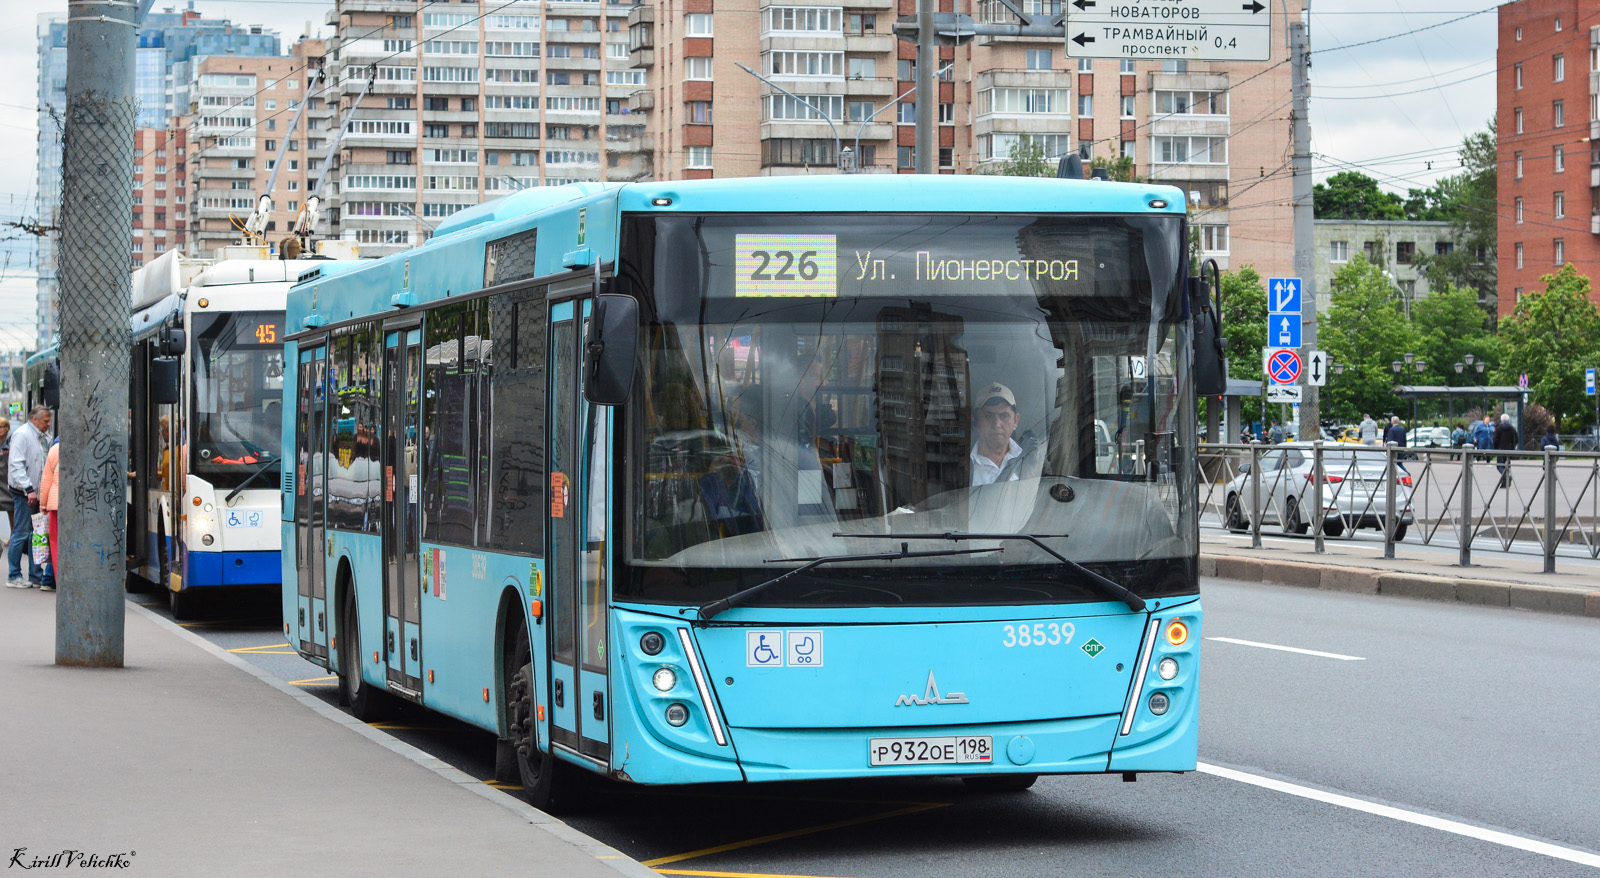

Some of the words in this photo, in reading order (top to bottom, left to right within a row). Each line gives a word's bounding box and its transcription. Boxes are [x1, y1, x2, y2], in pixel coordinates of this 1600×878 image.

[1110, 6, 1200, 19] НОВАТОРОВ
[1103, 26, 1208, 41] ТРАМВАЙНЫЙ
[1122, 44, 1187, 56] проспект
[1214, 37, 1237, 49] 0,4
[750, 250, 819, 281] 226
[855, 250, 896, 280] Ул.
[915, 250, 1079, 281] Пионерстроя
[255, 324, 276, 343] 45
[1003, 622, 1076, 647] 38539
[1085, 644, 1102, 652] СПГ
[958, 739, 987, 754] 198
